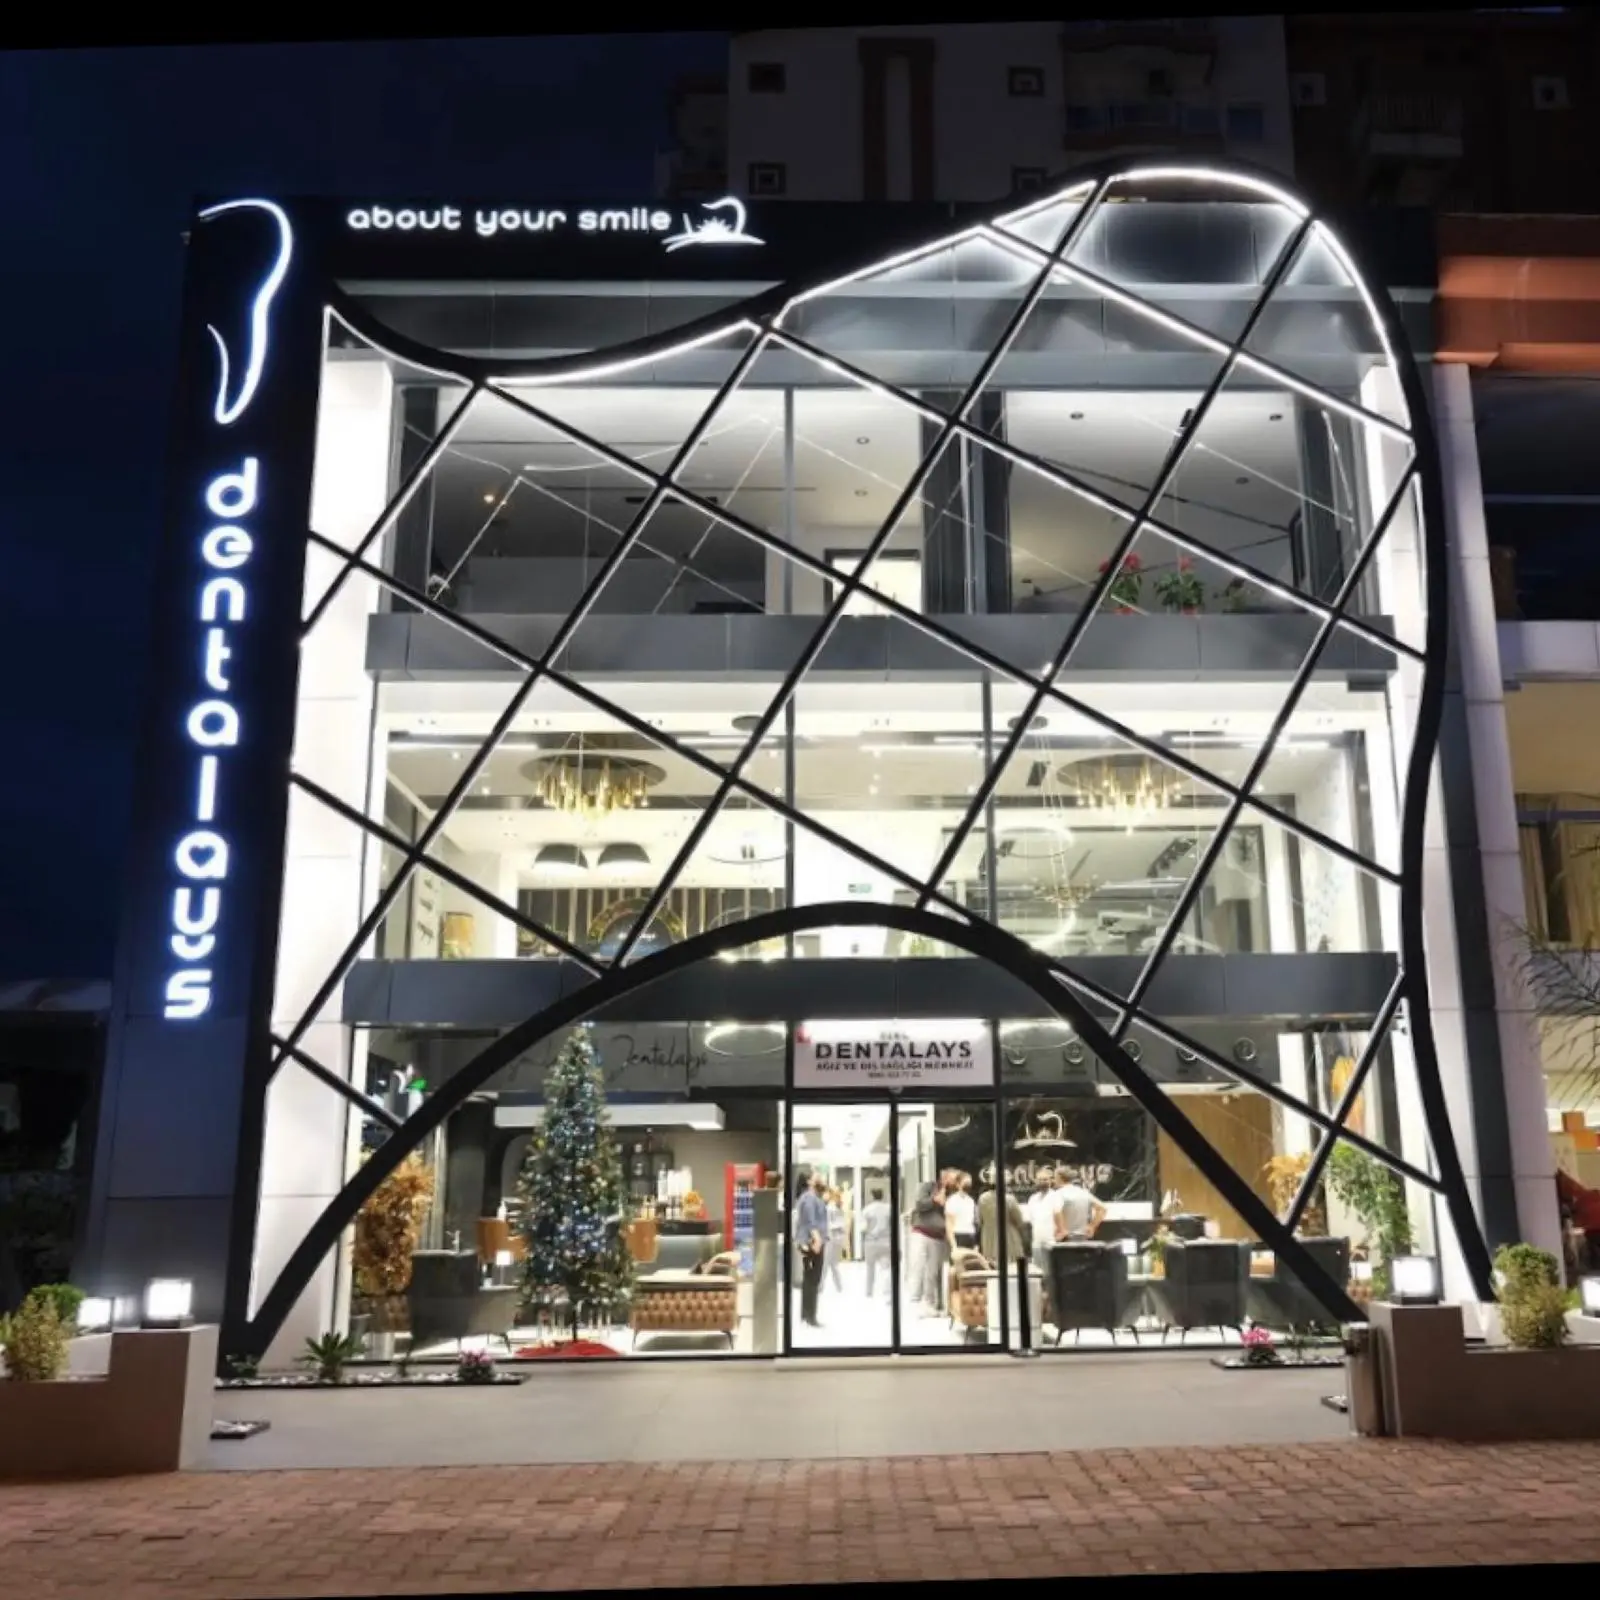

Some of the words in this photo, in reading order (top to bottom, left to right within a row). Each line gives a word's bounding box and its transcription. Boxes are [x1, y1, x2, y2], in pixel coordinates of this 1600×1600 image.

[346, 205, 462, 231] about
[475, 209, 567, 237] your
[577, 206, 672, 232] smile
[163, 456, 260, 1021] dentalays
[815, 1041, 972, 1059] DENTALAYS
